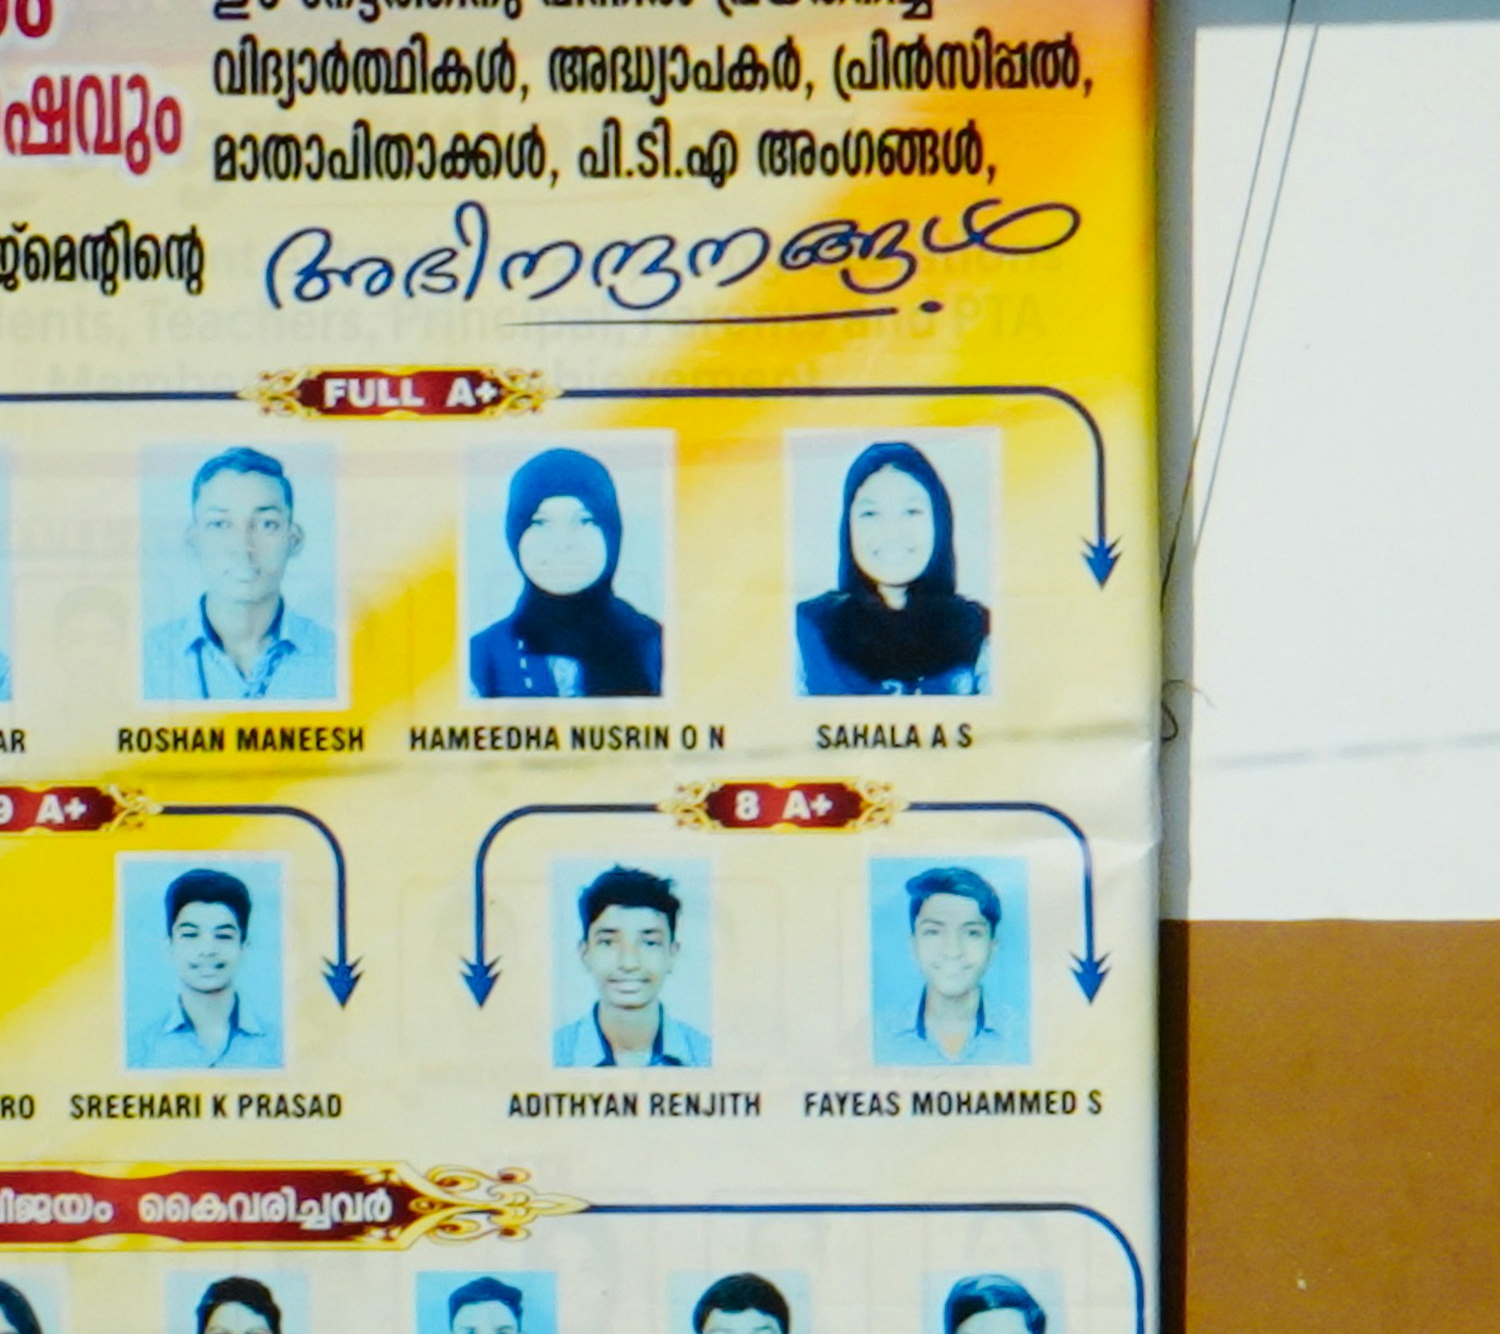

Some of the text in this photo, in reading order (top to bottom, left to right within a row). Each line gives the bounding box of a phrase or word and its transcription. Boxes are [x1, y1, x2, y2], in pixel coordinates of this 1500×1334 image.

[324, 379, 497, 409] FULL A+
[119, 727, 363, 752] ROSHAN MANEESH
[410, 725, 724, 750] HAMEEDHA NUSRIN O N
[817, 723, 972, 749] SAHALA A S
[36, 795, 86, 823] A+
[735, 791, 833, 821] 8 A+
[71, 1094, 341, 1119] SREEHARI K PRASAD
[509, 1092, 760, 1117] ADITHYAN RENJITH
[805, 1089, 1102, 1116] FAYEAS MOHAMMED S
